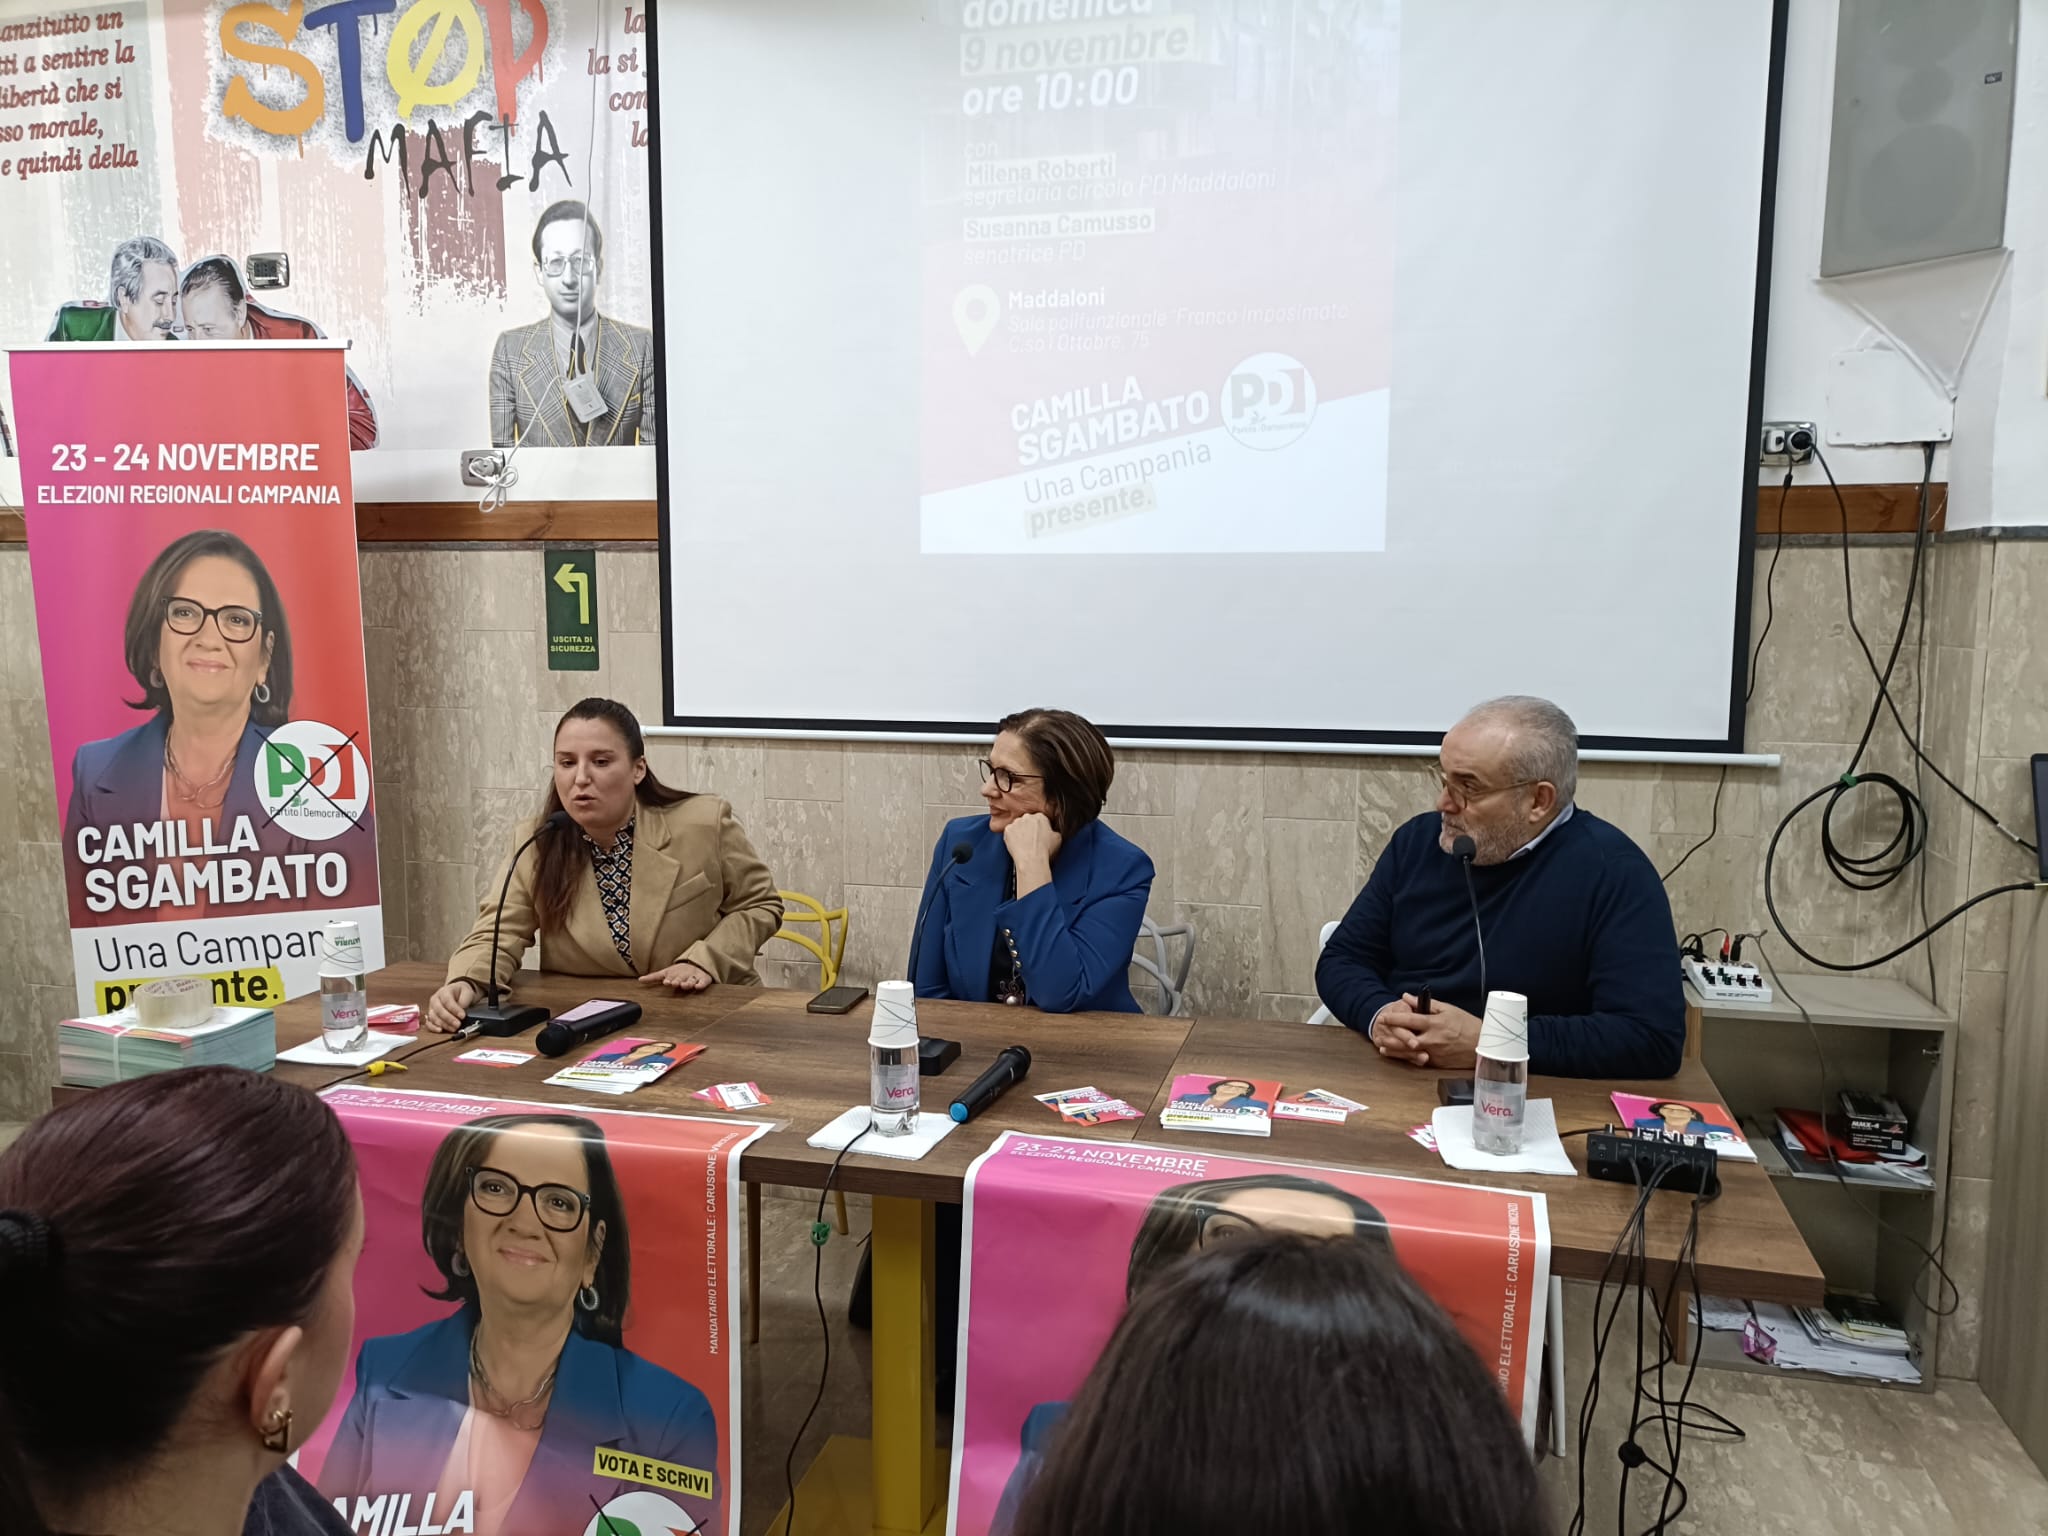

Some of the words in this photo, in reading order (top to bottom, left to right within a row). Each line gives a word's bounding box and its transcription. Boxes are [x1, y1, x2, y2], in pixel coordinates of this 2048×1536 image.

[0, 13, 91, 42] anzitutto
[96, 11, 124, 31] un
[24, 55, 36, 73] a
[41, 45, 109, 71] sentire
[115, 39, 135, 64] la
[587, 48, 611, 75] la
[617, 47, 639, 73] si
[964, 35, 987, 72] 9
[999, 24, 1190, 70] novembre
[65, 77, 99, 103] che
[104, 76, 123, 100] si
[219, 0, 549, 143] STOP
[962, 82, 1023, 117] ore
[1036, 66, 1139, 111] 10:00
[28, 111, 104, 140] morale,
[1, 159, 12, 176] e
[16, 146, 83, 181] quindi
[88, 143, 139, 170] della
[364, 110, 573, 199] MAFIA
[967, 161, 1032, 186] Milena
[1036, 156, 1115, 181] Roberti
[1171, 168, 1277, 194] Maddaloni
[966, 216, 1052, 241] Susanna
[1056, 211, 1151, 236] Camusso
[1008, 286, 1105, 310] Maddaloni
[1011, 376, 1143, 432] CAMILLA
[1018, 390, 1210, 467] SGAMBATO
[51, 444, 87, 472] 23
[113, 444, 149, 472] 24
[158, 443, 320, 472] NOVEMBRE
[1024, 477, 1074, 504] Una
[1079, 440, 1212, 491] Campania
[37, 485, 125, 505] ELEZIONI
[130, 485, 232, 505] REGIONALI
[238, 485, 341, 505] CAMPANIA
[1030, 484, 1154, 538] presente.
[550, 645, 596, 653] SICUREZZA
[77, 815, 260, 864] CAMILLA
[85, 852, 348, 913] SGAMBATO
[95, 937, 167, 973] Una
[177, 929, 325, 969] Campan
[105, 971, 278, 1014] pnte.
[1010, 1150, 1065, 1160] ELEZIONI
[1067, 1155, 1136, 1169] REGIONALI
[1137, 1164, 1205, 1178] CAMPANIA
[1078, 1149, 1209, 1173] NOVEMBRE
[706, 1153, 717, 1213] CARUSONE
[708, 1288, 719, 1355] MANDATARIO
[598, 1453, 640, 1477] VOTA
[643, 1464, 653, 1480] E
[655, 1465, 709, 1494] SCRIVI
[332, 1490, 475, 1536] MILLA
